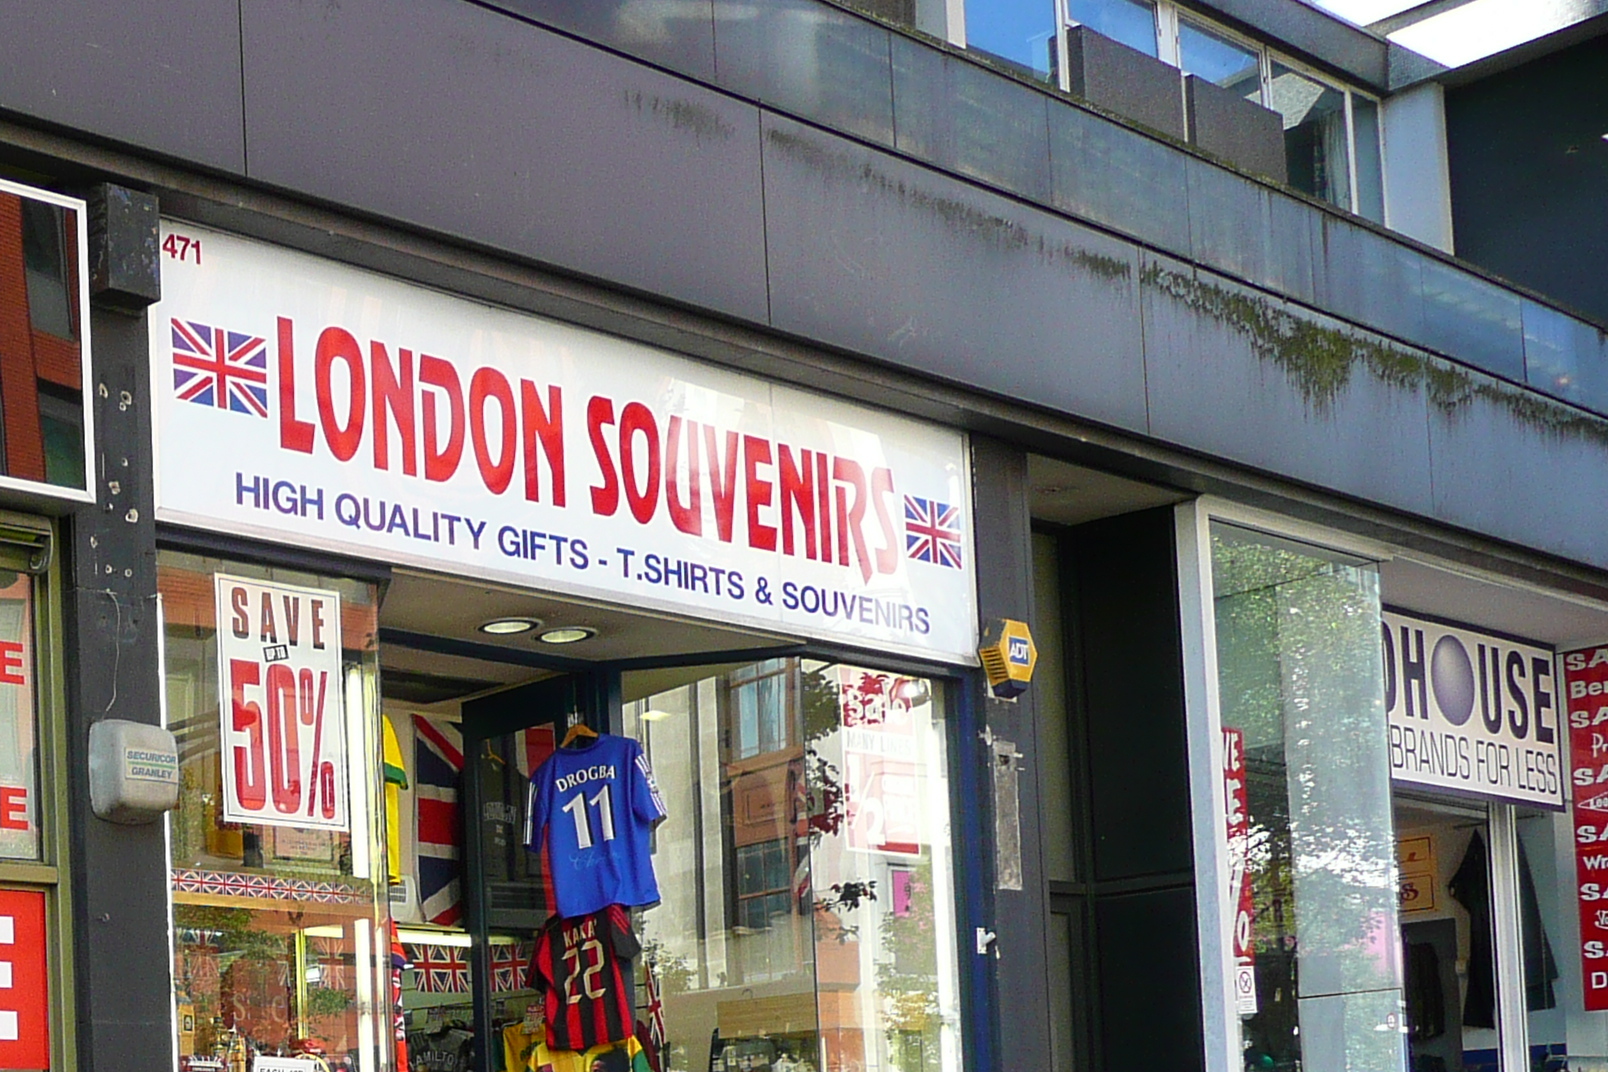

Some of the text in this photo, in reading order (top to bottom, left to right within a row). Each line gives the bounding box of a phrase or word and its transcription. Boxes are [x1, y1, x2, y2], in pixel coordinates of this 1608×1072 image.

[161, 233, 203, 266] 471
[277, 316, 897, 585] LONDON SOUVENIRS
[235, 472, 324, 522] HIGH
[335, 491, 485, 551] QUALITY
[497, 528, 589, 571] GIFTS
[617, 547, 745, 601] T.SHIRTS
[754, 576, 772, 606] &
[782, 582, 930, 635] SOUVENIRS
[231, 586, 325, 650] SAVE
[1010, 642, 1029, 660] ADT
[127, 750, 176, 764] SECURICOR
[230, 659, 335, 820] 50%
[1391, 724, 1558, 796] BRANDS FOR LESS
[131, 766, 172, 779] GRANLEY
[555, 765, 616, 792] DROGBA
[561, 784, 616, 849] 11
[561, 939, 606, 1004] 22
